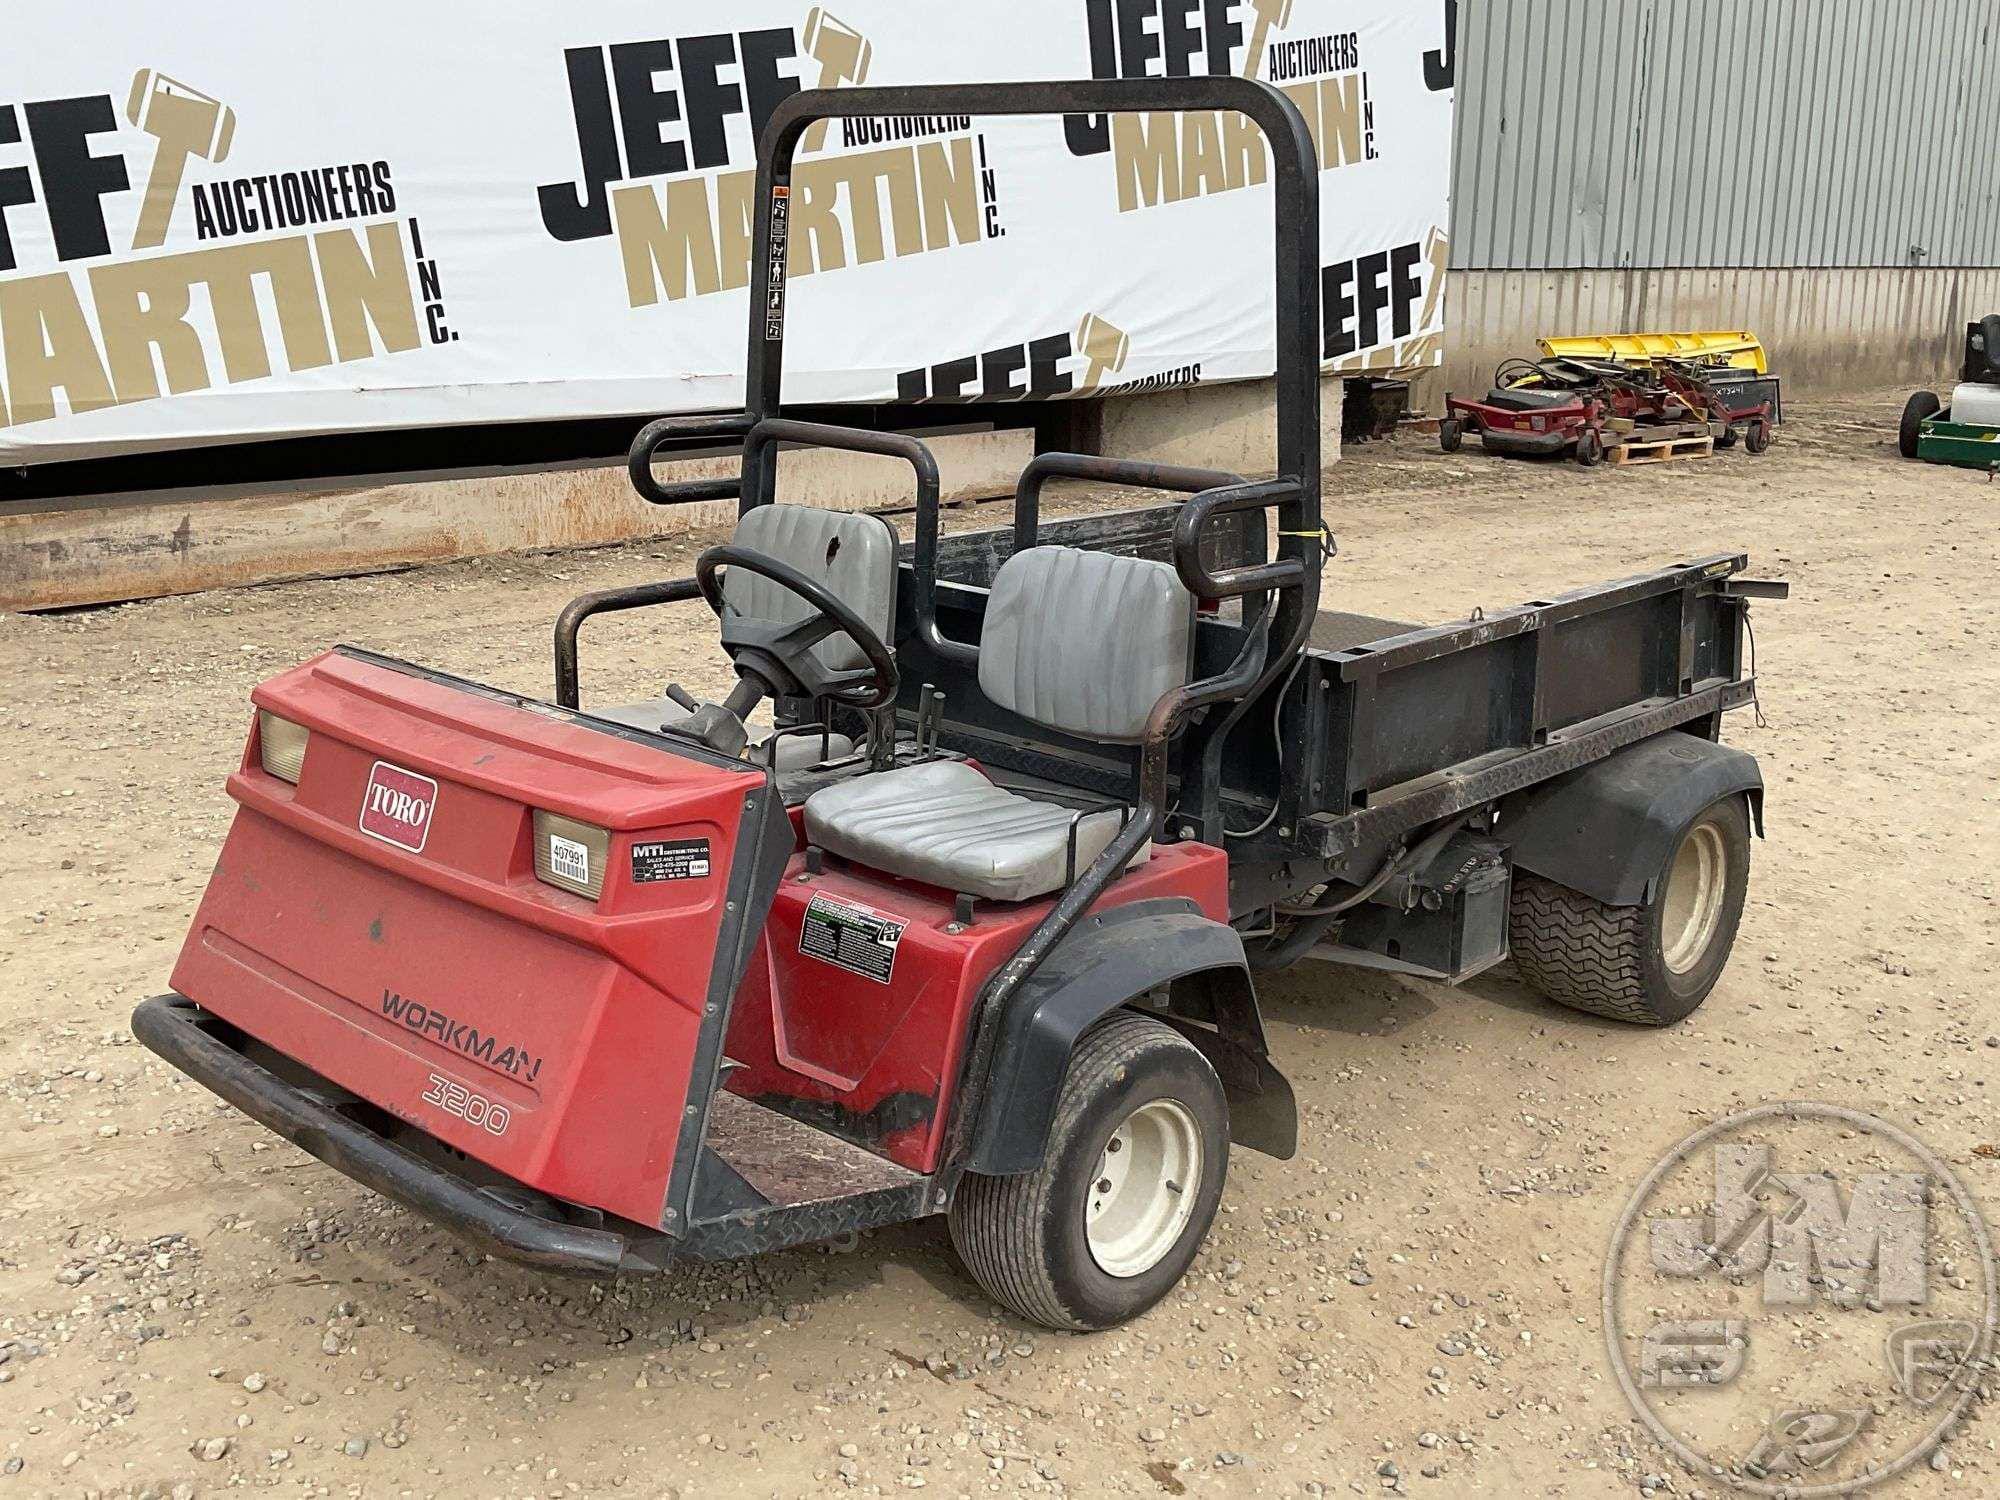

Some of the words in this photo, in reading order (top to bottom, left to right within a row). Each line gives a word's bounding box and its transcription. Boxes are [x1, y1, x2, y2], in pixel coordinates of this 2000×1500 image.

[1269, 31, 1358, 82] AUCTIONEERS
[537, 26, 800, 242] JEFF
[1112, 74, 1362, 213] MARIN
[1362, 71, 1379, 161] INC.
[191, 160, 397, 240] AUCTIONEERS
[978, 133, 1005, 239] INC.
[0, 221, 421, 429] ARTIN
[408, 217, 459, 345] INC.
[1321, 242, 1422, 361] EFF
[370, 782, 428, 827] TORO
[553, 844, 584, 866] 407991
[632, 844, 664, 858] MTI
[382, 988, 543, 1082] WORKMAN
[422, 1072, 511, 1136] 3200
